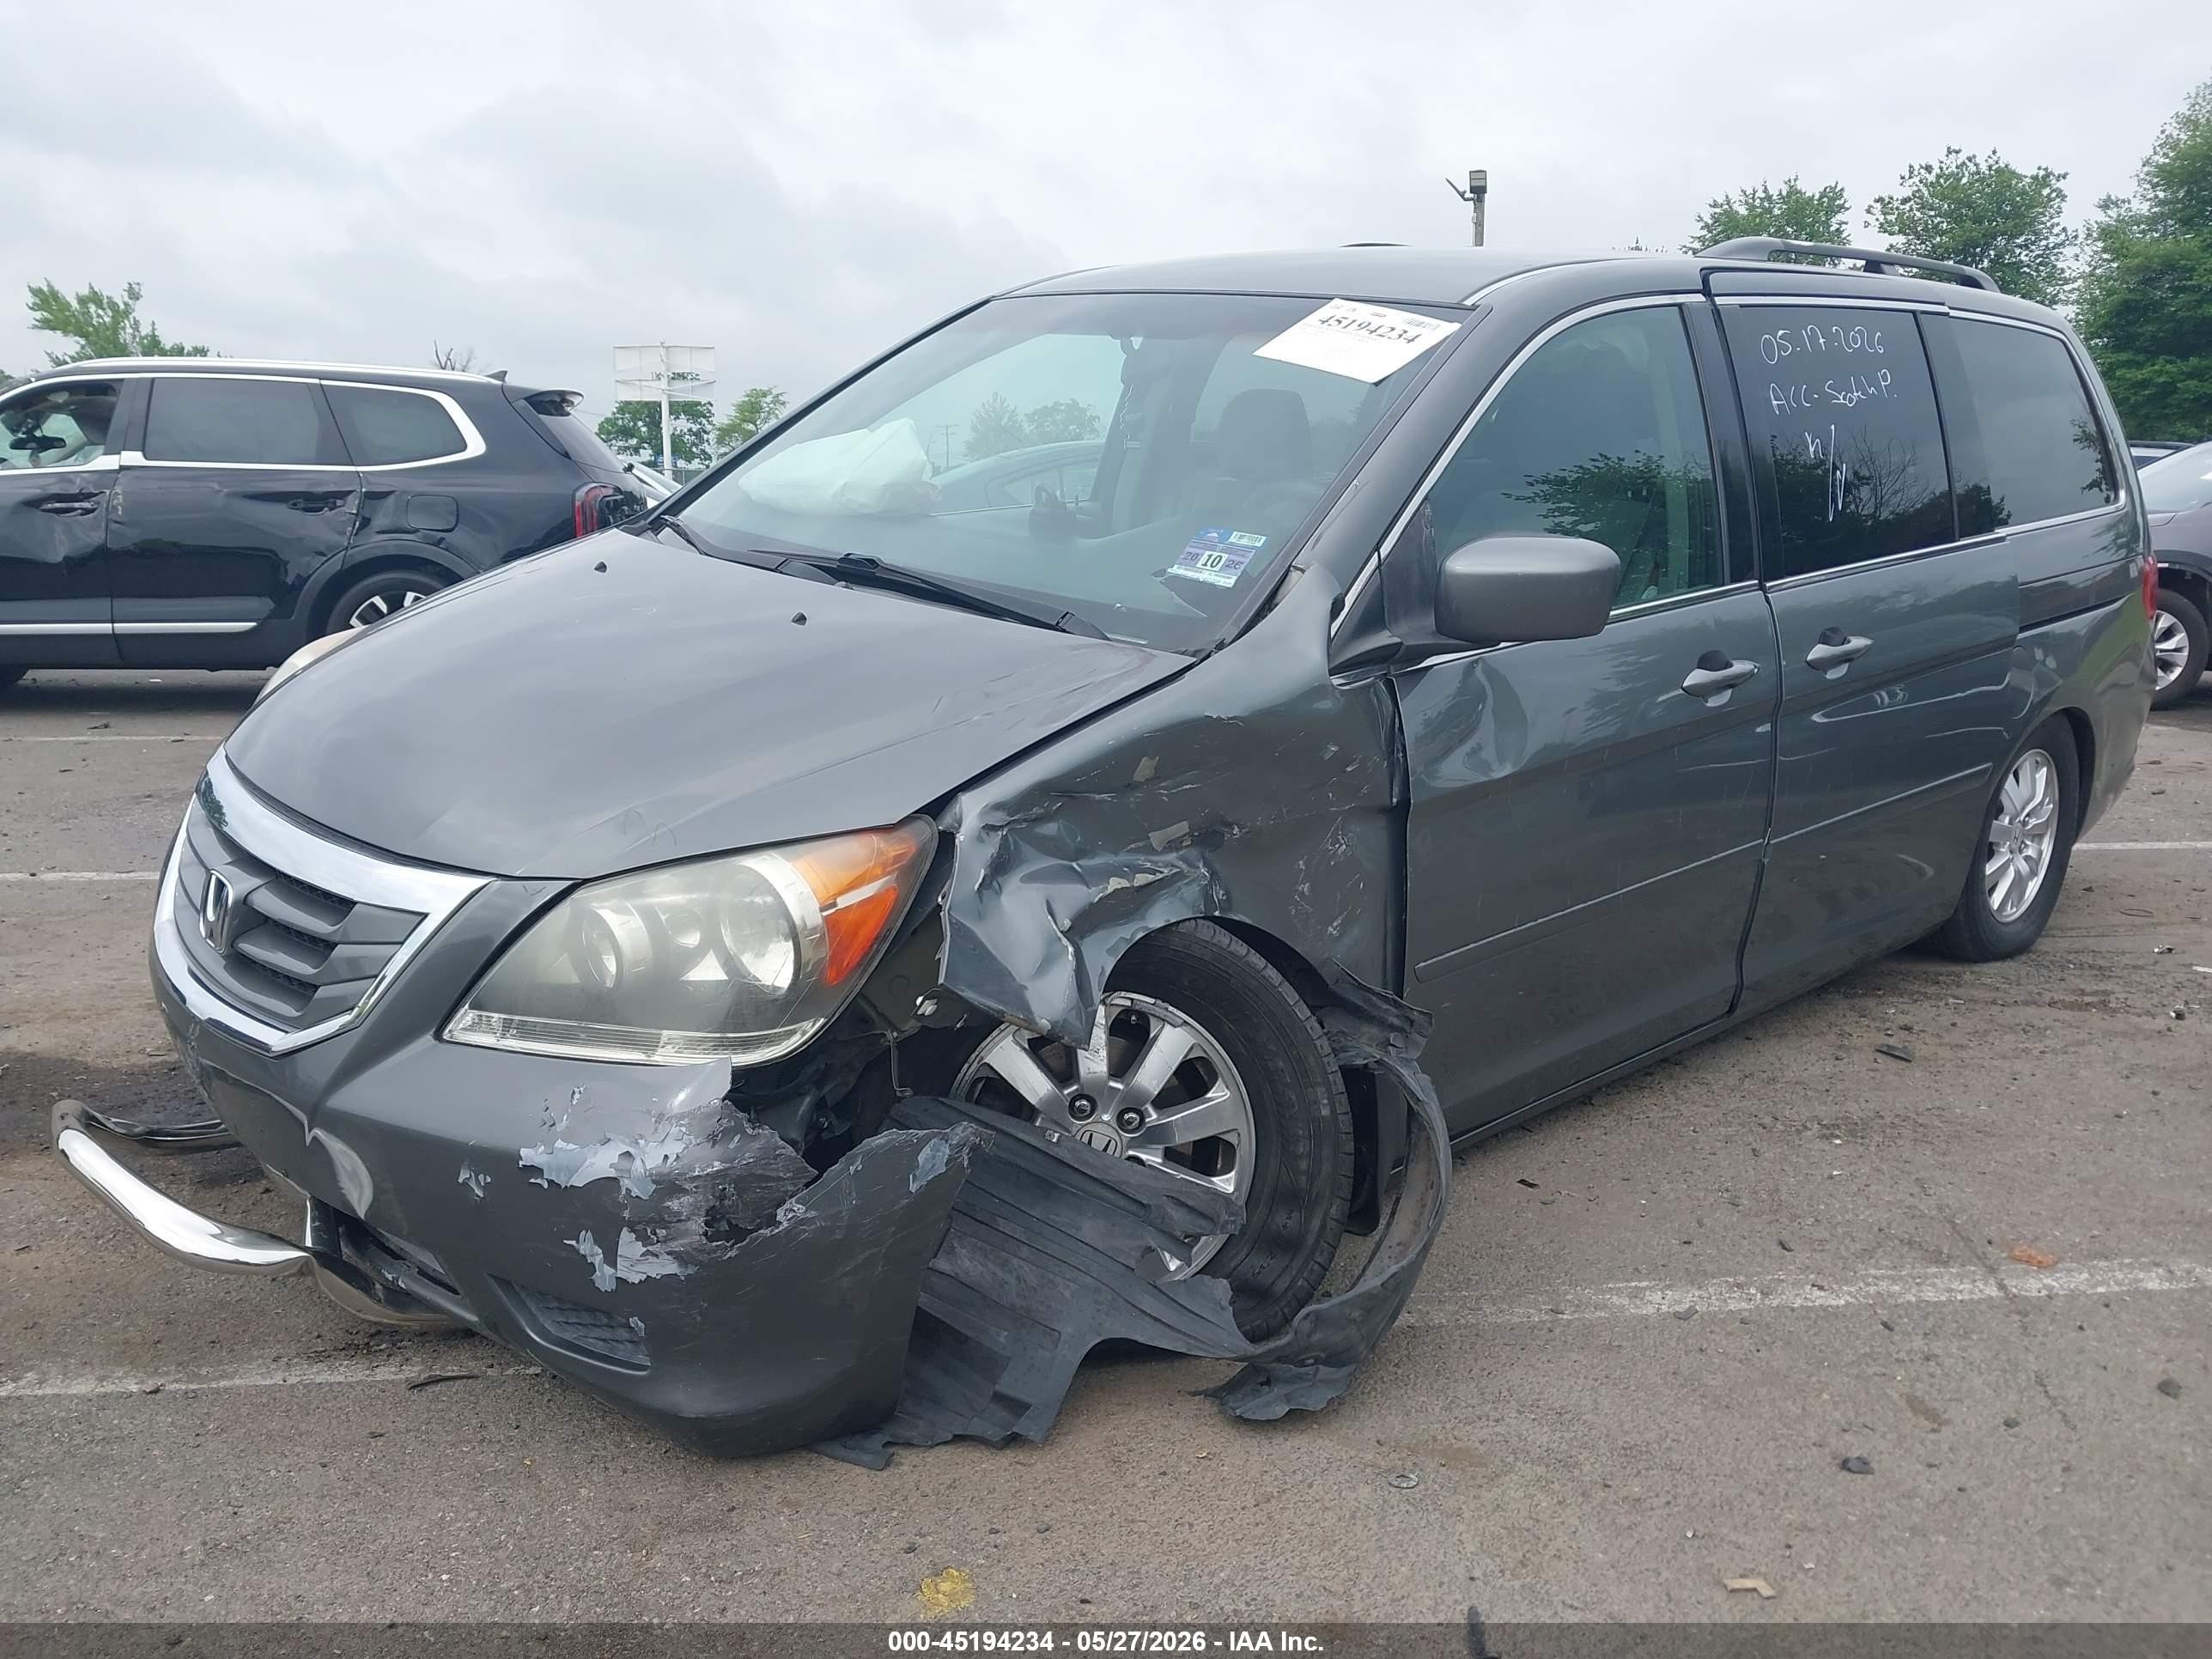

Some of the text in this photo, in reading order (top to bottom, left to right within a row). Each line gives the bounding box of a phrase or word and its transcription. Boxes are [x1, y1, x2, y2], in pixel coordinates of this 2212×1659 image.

[1318, 314, 1423, 343] 45194234
[1182, 551, 1243, 570] 20 10 26
